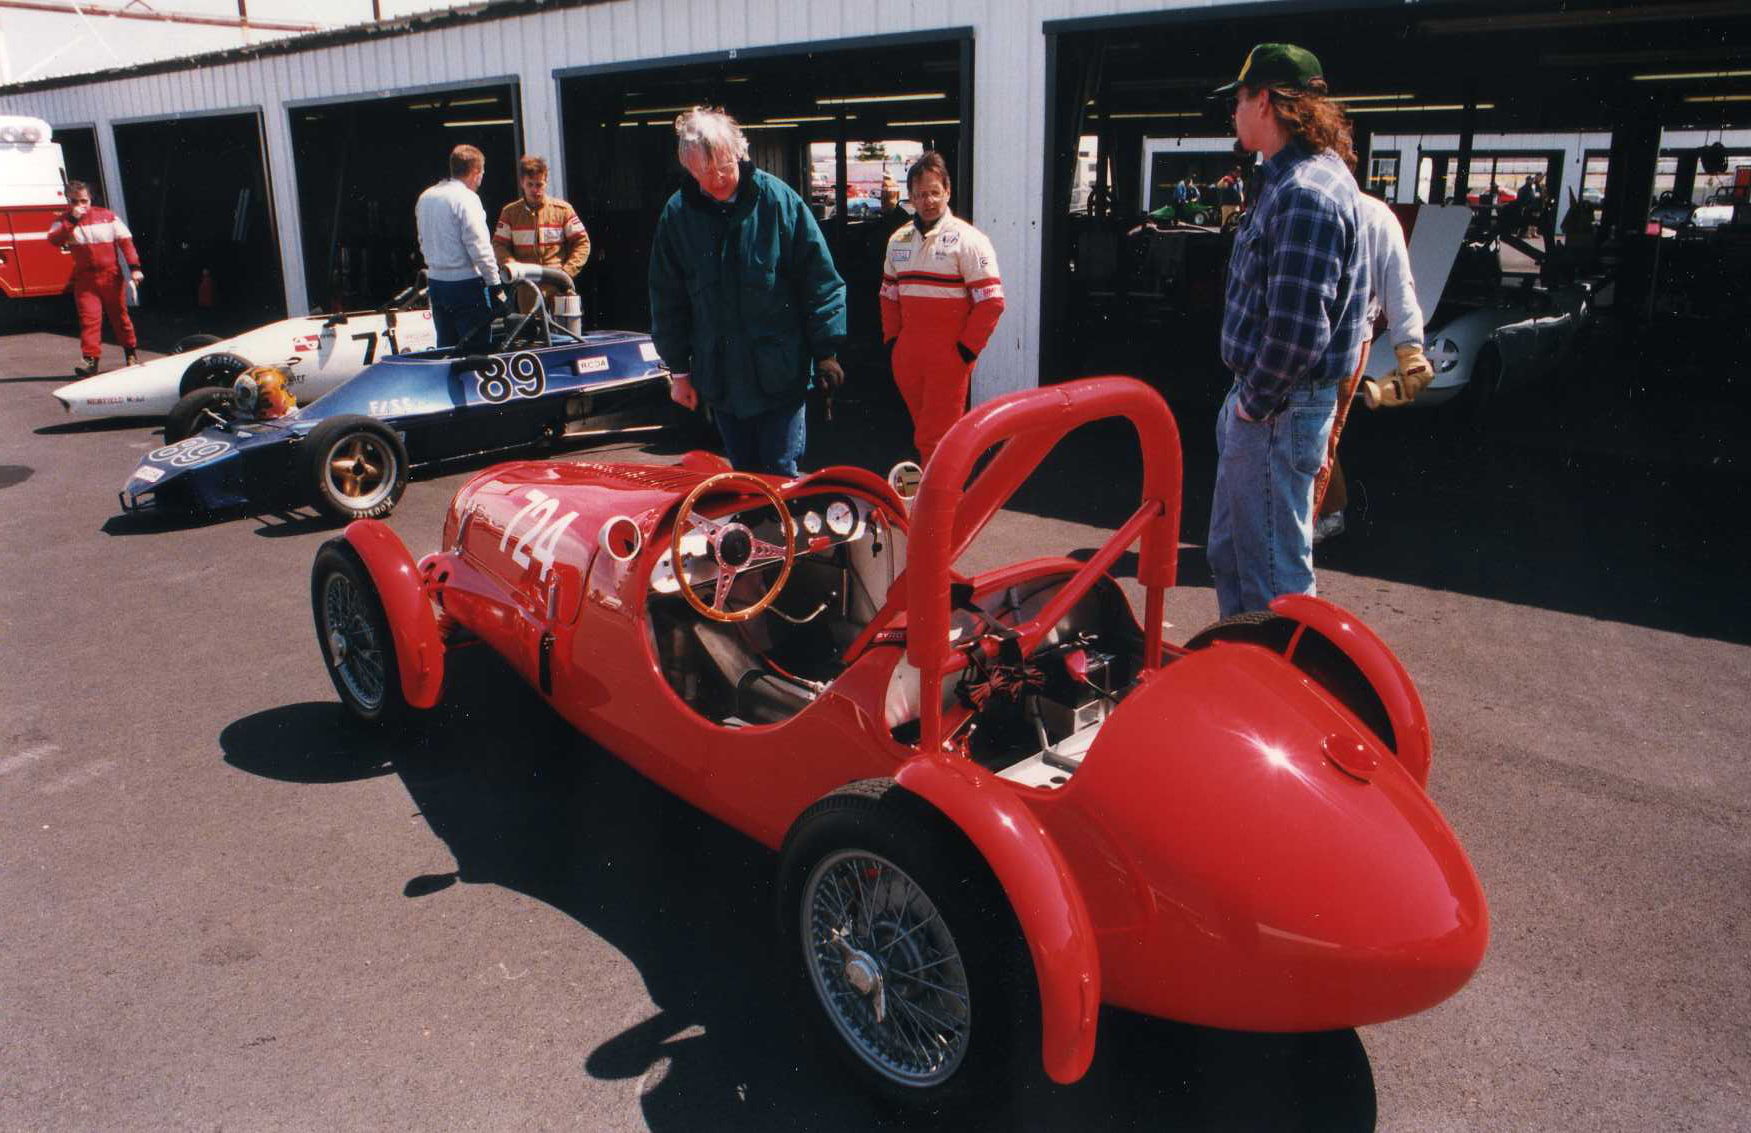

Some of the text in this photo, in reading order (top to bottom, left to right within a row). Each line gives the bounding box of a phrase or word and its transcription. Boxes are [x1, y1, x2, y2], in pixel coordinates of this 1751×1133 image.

[474, 351, 546, 405] 89
[149, 436, 231, 467] 89
[499, 489, 580, 583] 724
